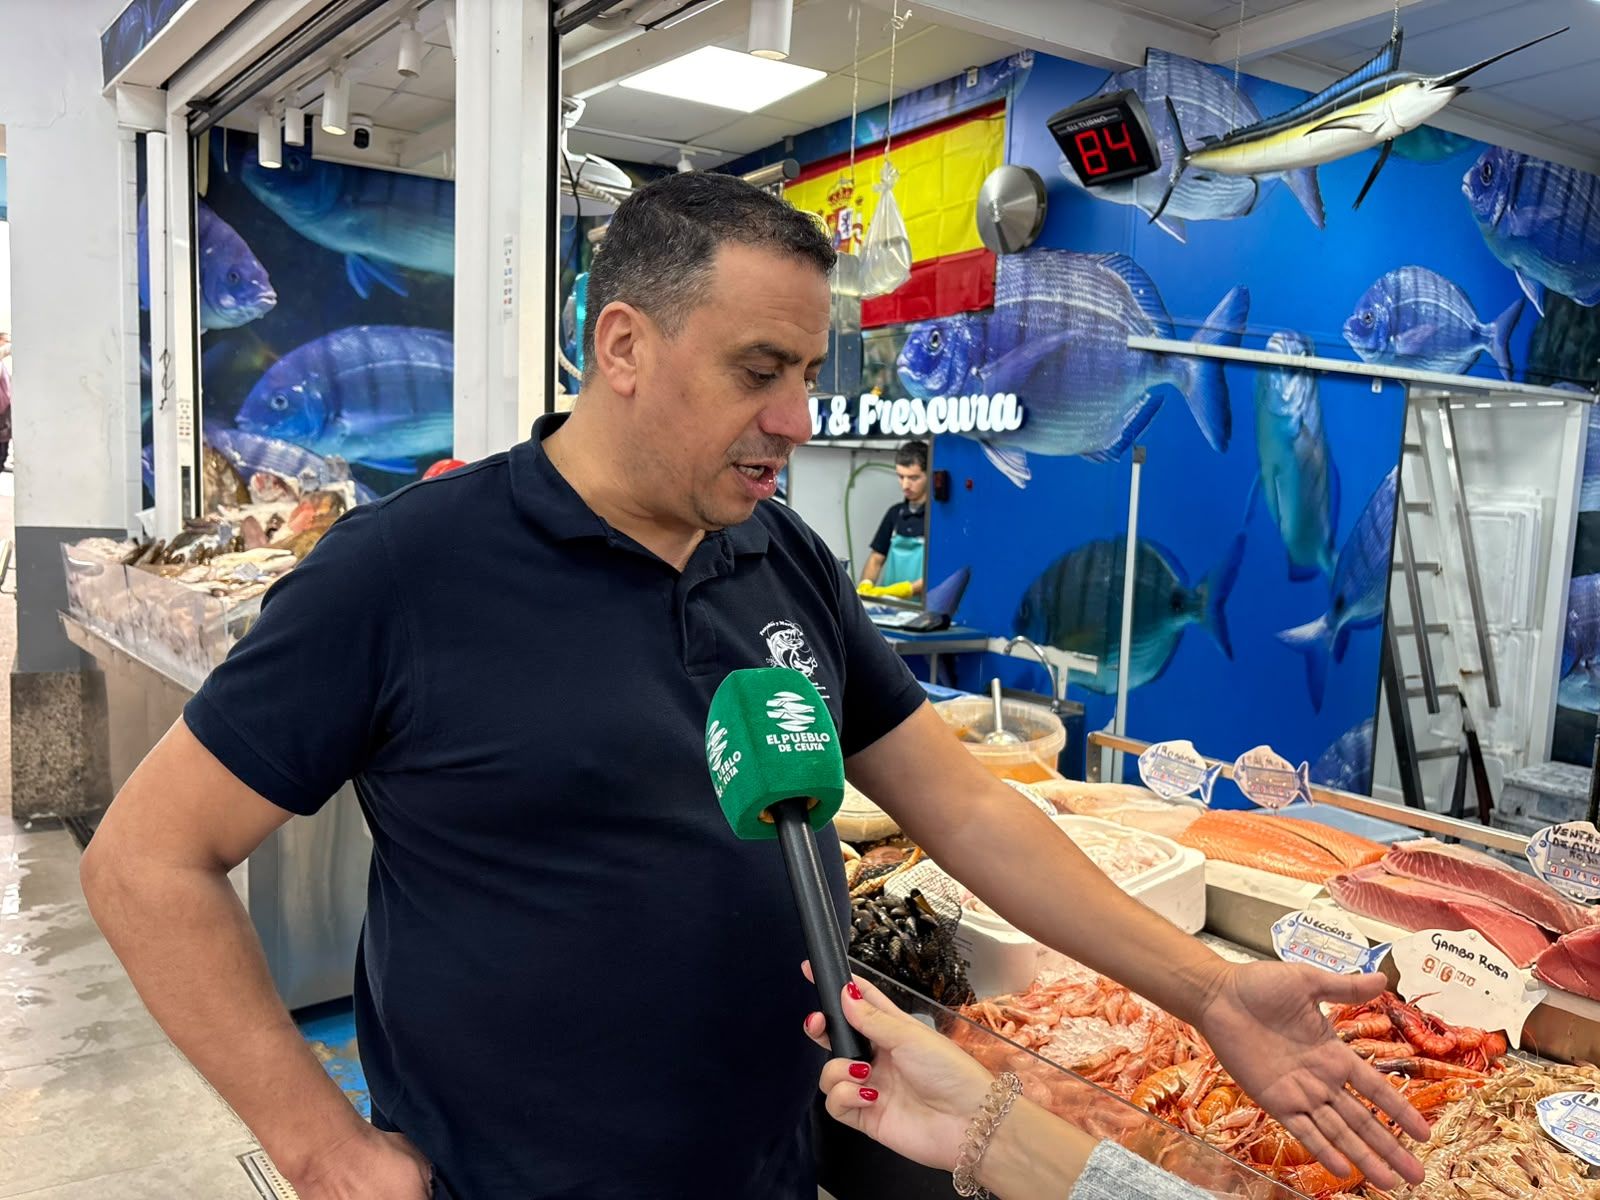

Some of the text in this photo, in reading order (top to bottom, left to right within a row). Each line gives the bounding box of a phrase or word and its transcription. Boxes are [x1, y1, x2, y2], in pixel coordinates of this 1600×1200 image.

[1074, 121, 1137, 175] 84
[828, 395, 851, 436] &
[859, 392, 1023, 436] Frescura
[766, 732, 831, 745] EL PUEBLO
[778, 743, 825, 753] DE CEUTA
[1552, 825, 1600, 845] VENTRE
[1431, 933, 1475, 960] GAMBA
